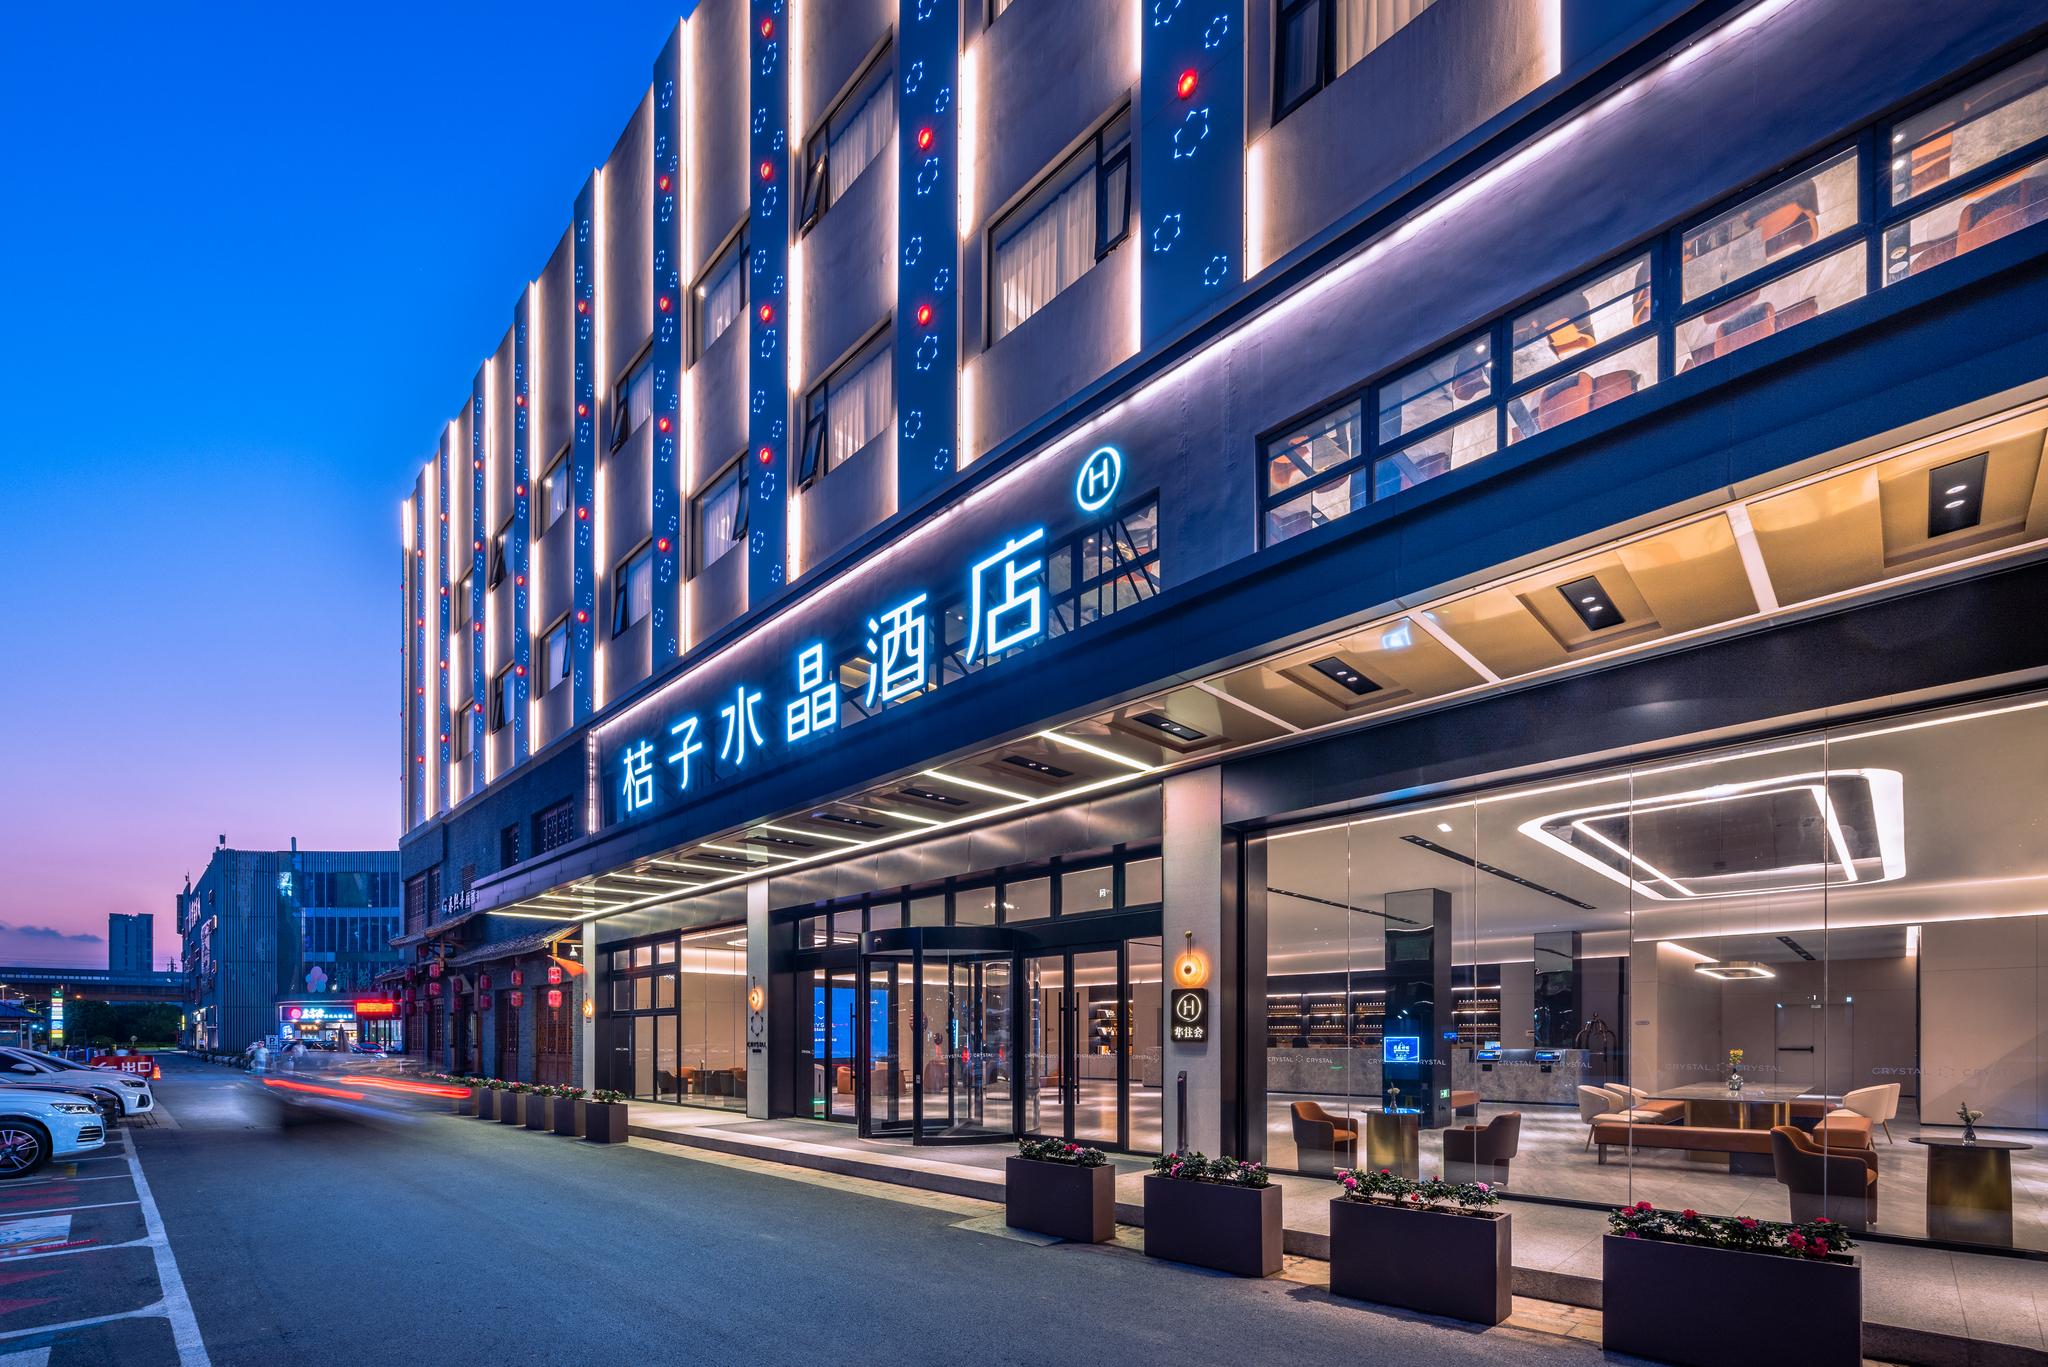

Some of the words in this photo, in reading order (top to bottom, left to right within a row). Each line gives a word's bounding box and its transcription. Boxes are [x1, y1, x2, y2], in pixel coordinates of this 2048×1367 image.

[621, 527, 1045, 813] 桔子水晶酒店
[1174, 1026, 1204, 1039] 华住会
[121, 1062, 151, 1073] 出口
[1416, 1058, 1447, 1066] RYSTAL
[1498, 1059, 1534, 1067] CRYSTAL
[1664, 1062, 1712, 1072] CRYSTAL
[1736, 1064, 1785, 1073] CRYSTAL
